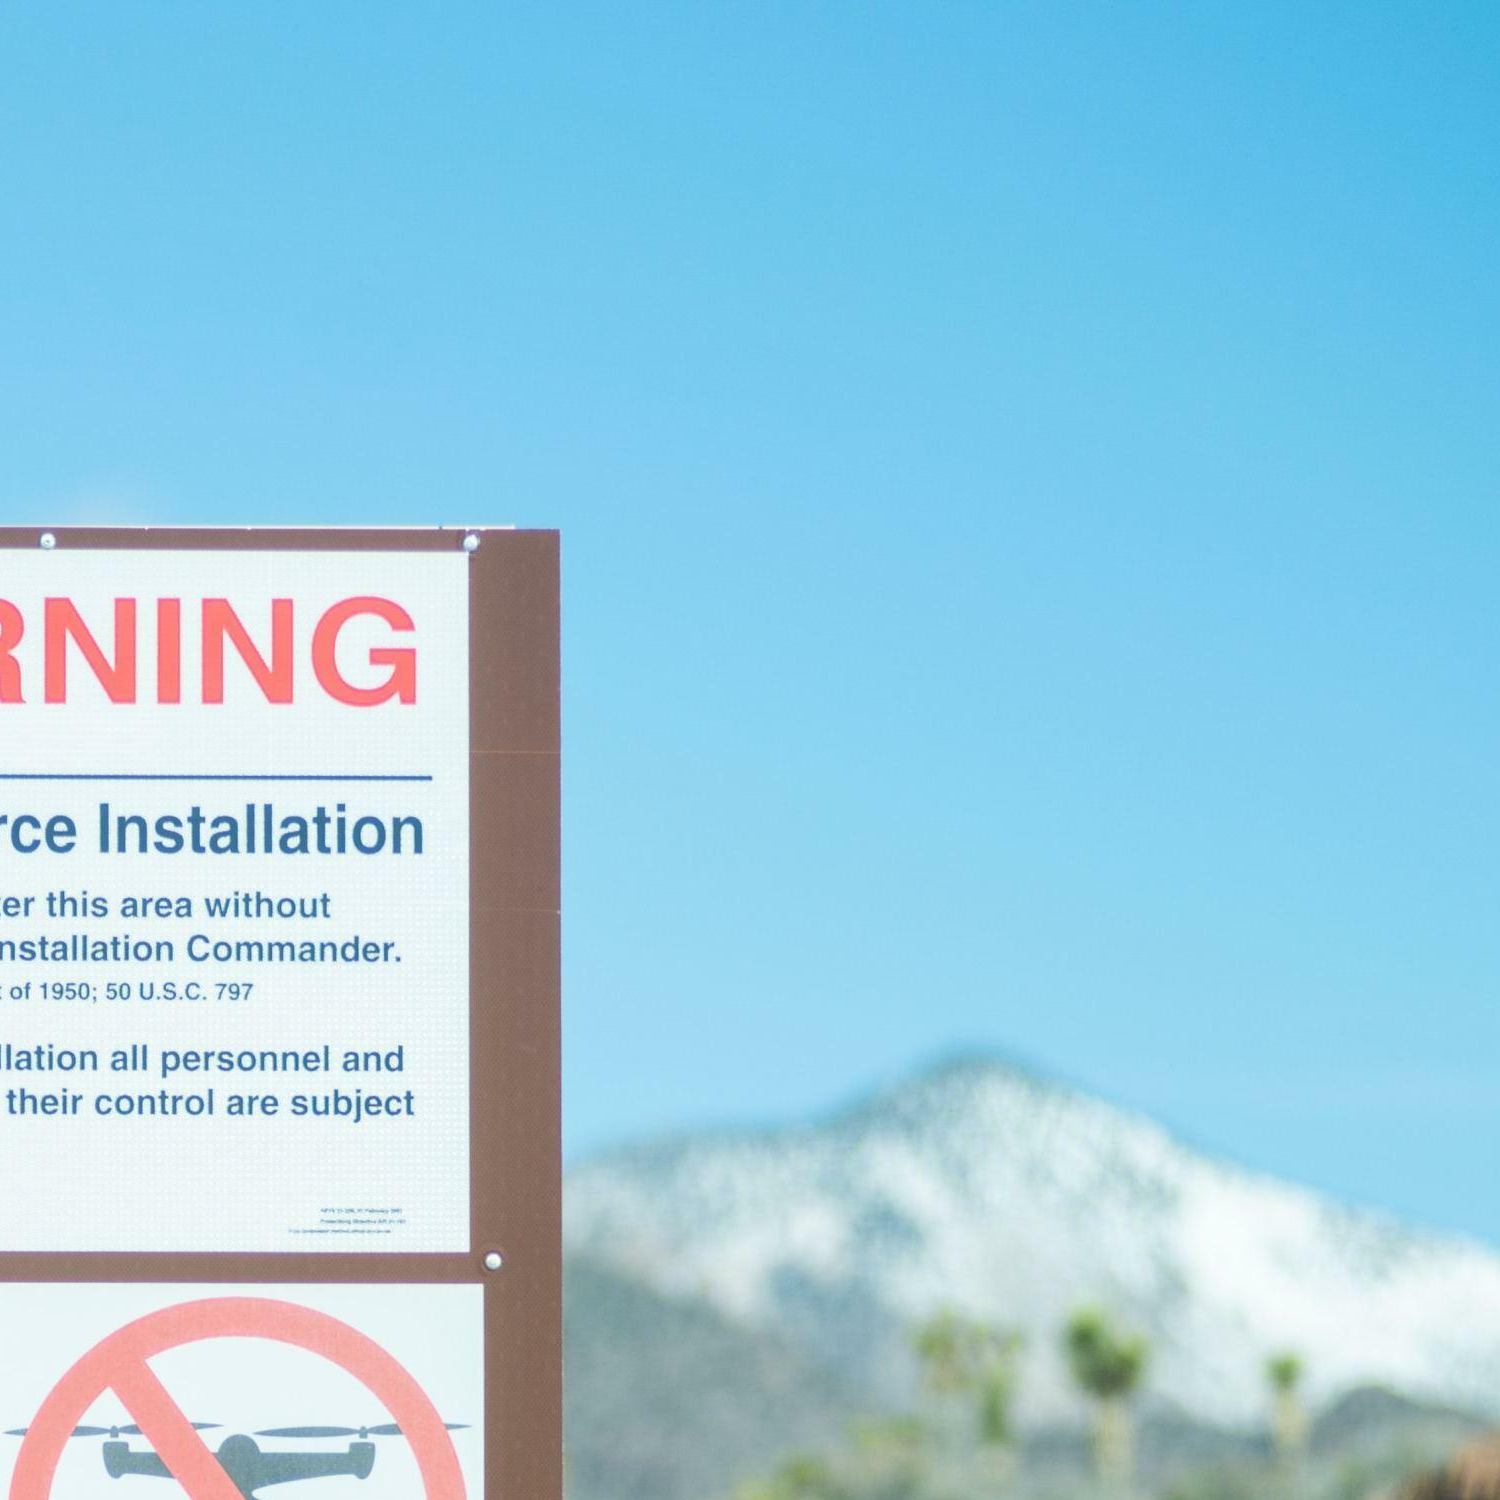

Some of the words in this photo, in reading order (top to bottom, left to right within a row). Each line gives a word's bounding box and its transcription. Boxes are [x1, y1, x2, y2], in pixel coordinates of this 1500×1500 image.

[98, 802, 424, 856] Installation
[45, 889, 109, 919] this
[119, 896, 193, 919] area
[203, 890, 331, 919] without
[186, 933, 402, 964] Commander.
[8, 981, 33, 1001] of
[38, 981, 98, 1005] 1950;
[105, 981, 133, 1002] 50
[138, 981, 208, 1002] U.S.C.
[213, 981, 255, 1002] 797
[110, 1043, 148, 1072] all
[160, 1044, 330, 1079] personnel
[341, 1044, 405, 1073] and
[5, 1087, 84, 1116] their
[94, 1088, 214, 1116] control
[226, 1094, 280, 1117] are
[290, 1088, 415, 1124] subject
